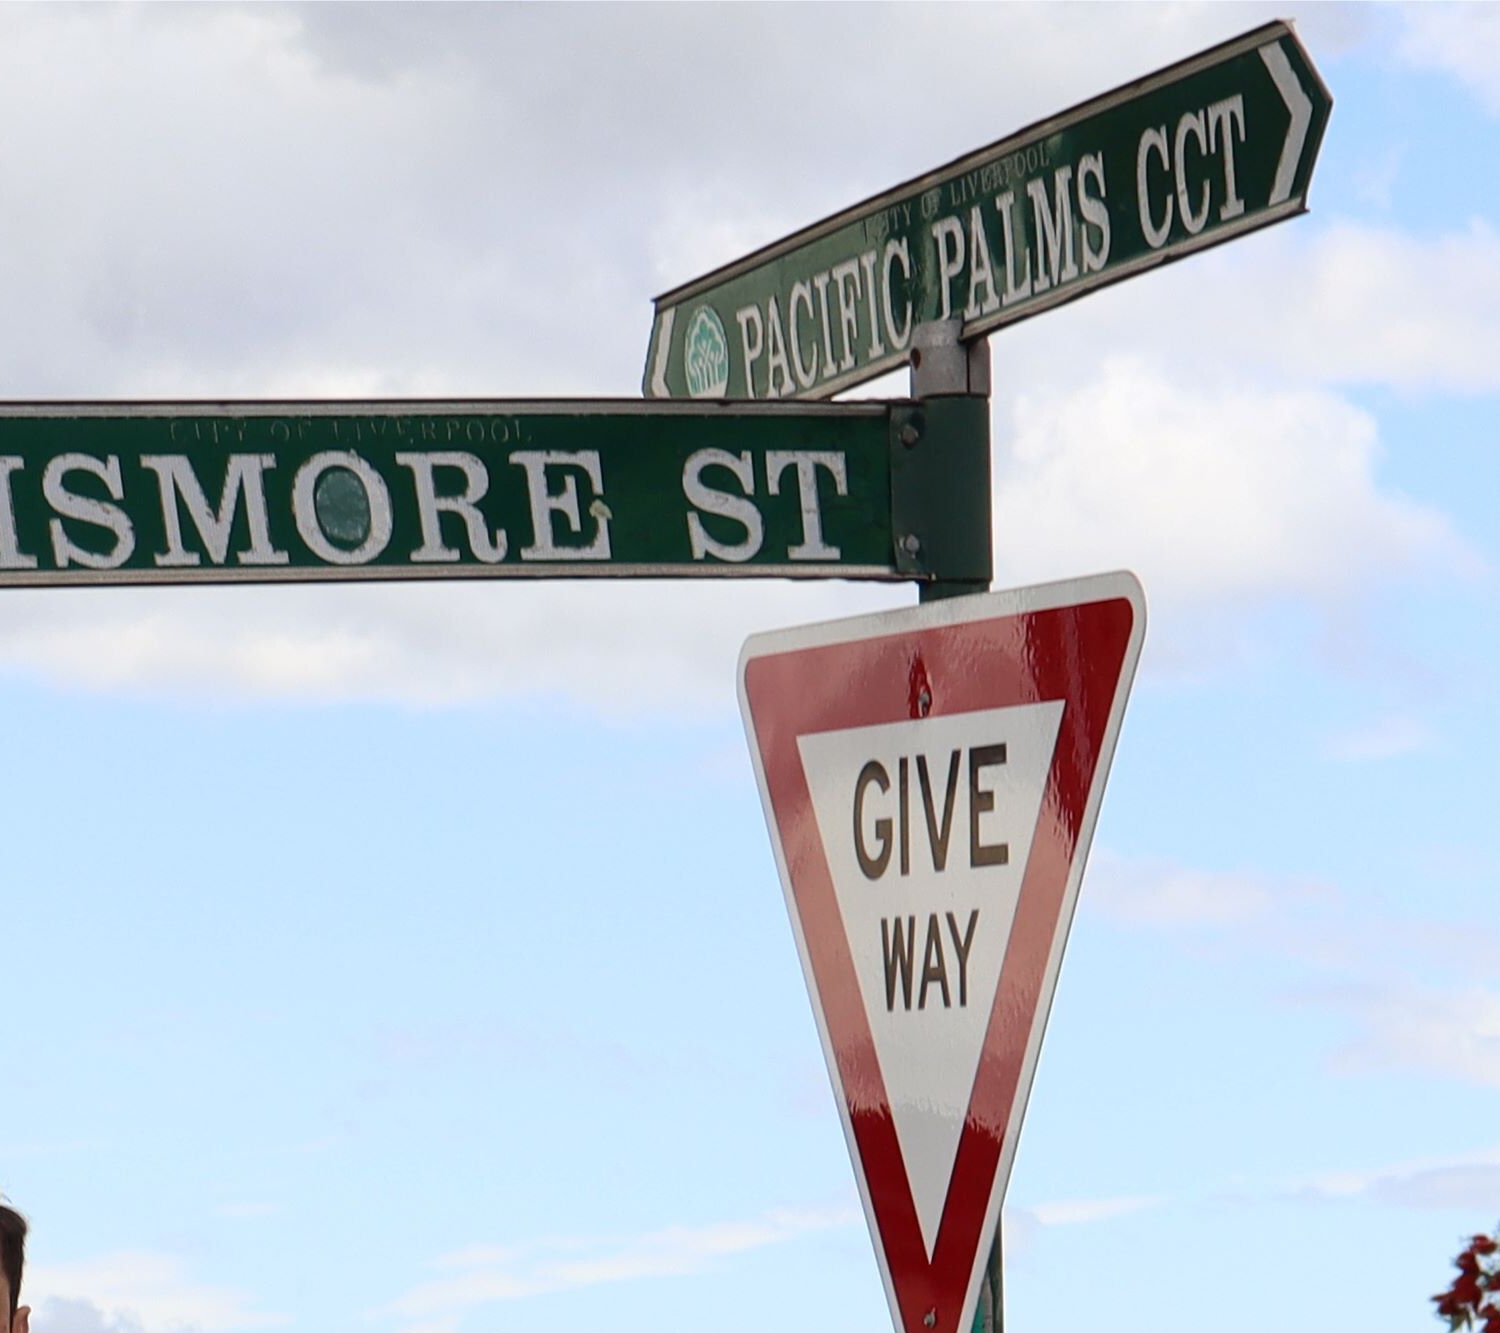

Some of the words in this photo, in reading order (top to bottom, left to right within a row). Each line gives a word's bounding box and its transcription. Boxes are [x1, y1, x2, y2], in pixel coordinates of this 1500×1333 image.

[921, 187, 942, 217] OF
[950, 143, 1051, 206] LIVERPOOL
[736, 237, 913, 398] PACIFIC
[933, 150, 1111, 321] PALMS
[1136, 94, 1245, 249] CCT
[683, 448, 850, 562] ST
[853, 741, 1009, 881] GIVE
[881, 909, 980, 1012] WAY
